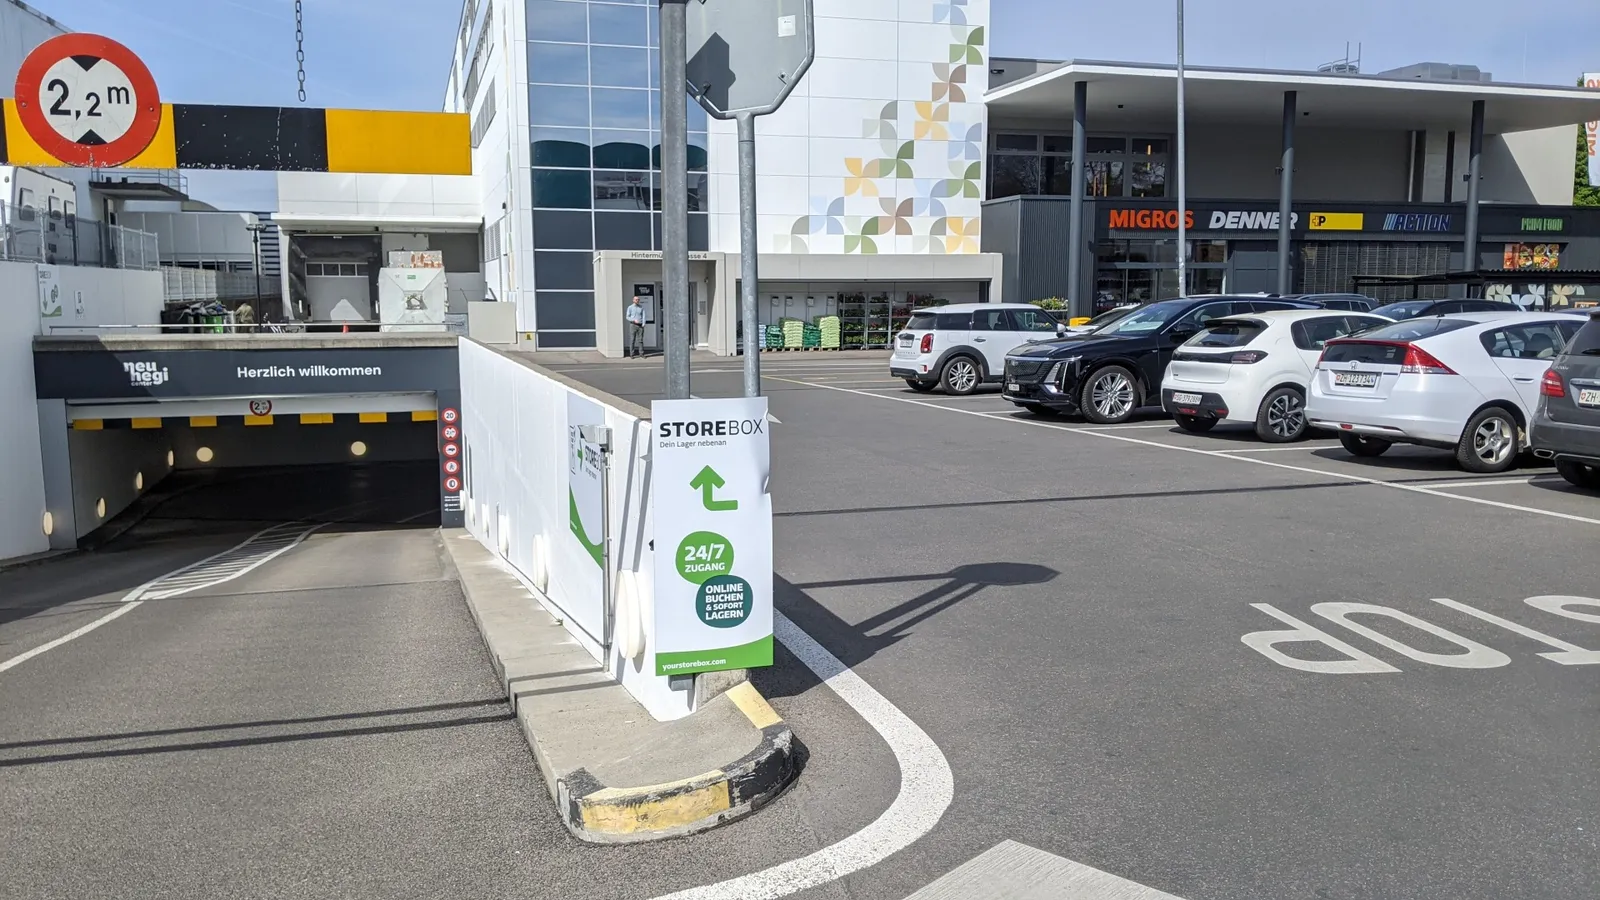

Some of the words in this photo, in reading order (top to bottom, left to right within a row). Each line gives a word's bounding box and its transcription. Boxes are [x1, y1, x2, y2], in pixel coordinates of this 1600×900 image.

[1109, 209, 1194, 229] MIGROS
[1391, 213, 1451, 231] ACTION
[237, 366, 296, 379] Herzlich
[298, 365, 382, 377] willkommen
[659, 419, 764, 438] STOREBOX
[676, 440, 696, 449] Lager
[697, 439, 727, 447] nebenan
[684, 543, 725, 562] 24/7
[684, 562, 726, 573] ZUGANG
[705, 583, 744, 594] ONLINE
[705, 593, 744, 604] BUCHEN
[713, 602, 744, 611] SOFORT
[705, 609, 744, 620] LAGERN
[662, 658, 727, 671] yourstorebox.com
